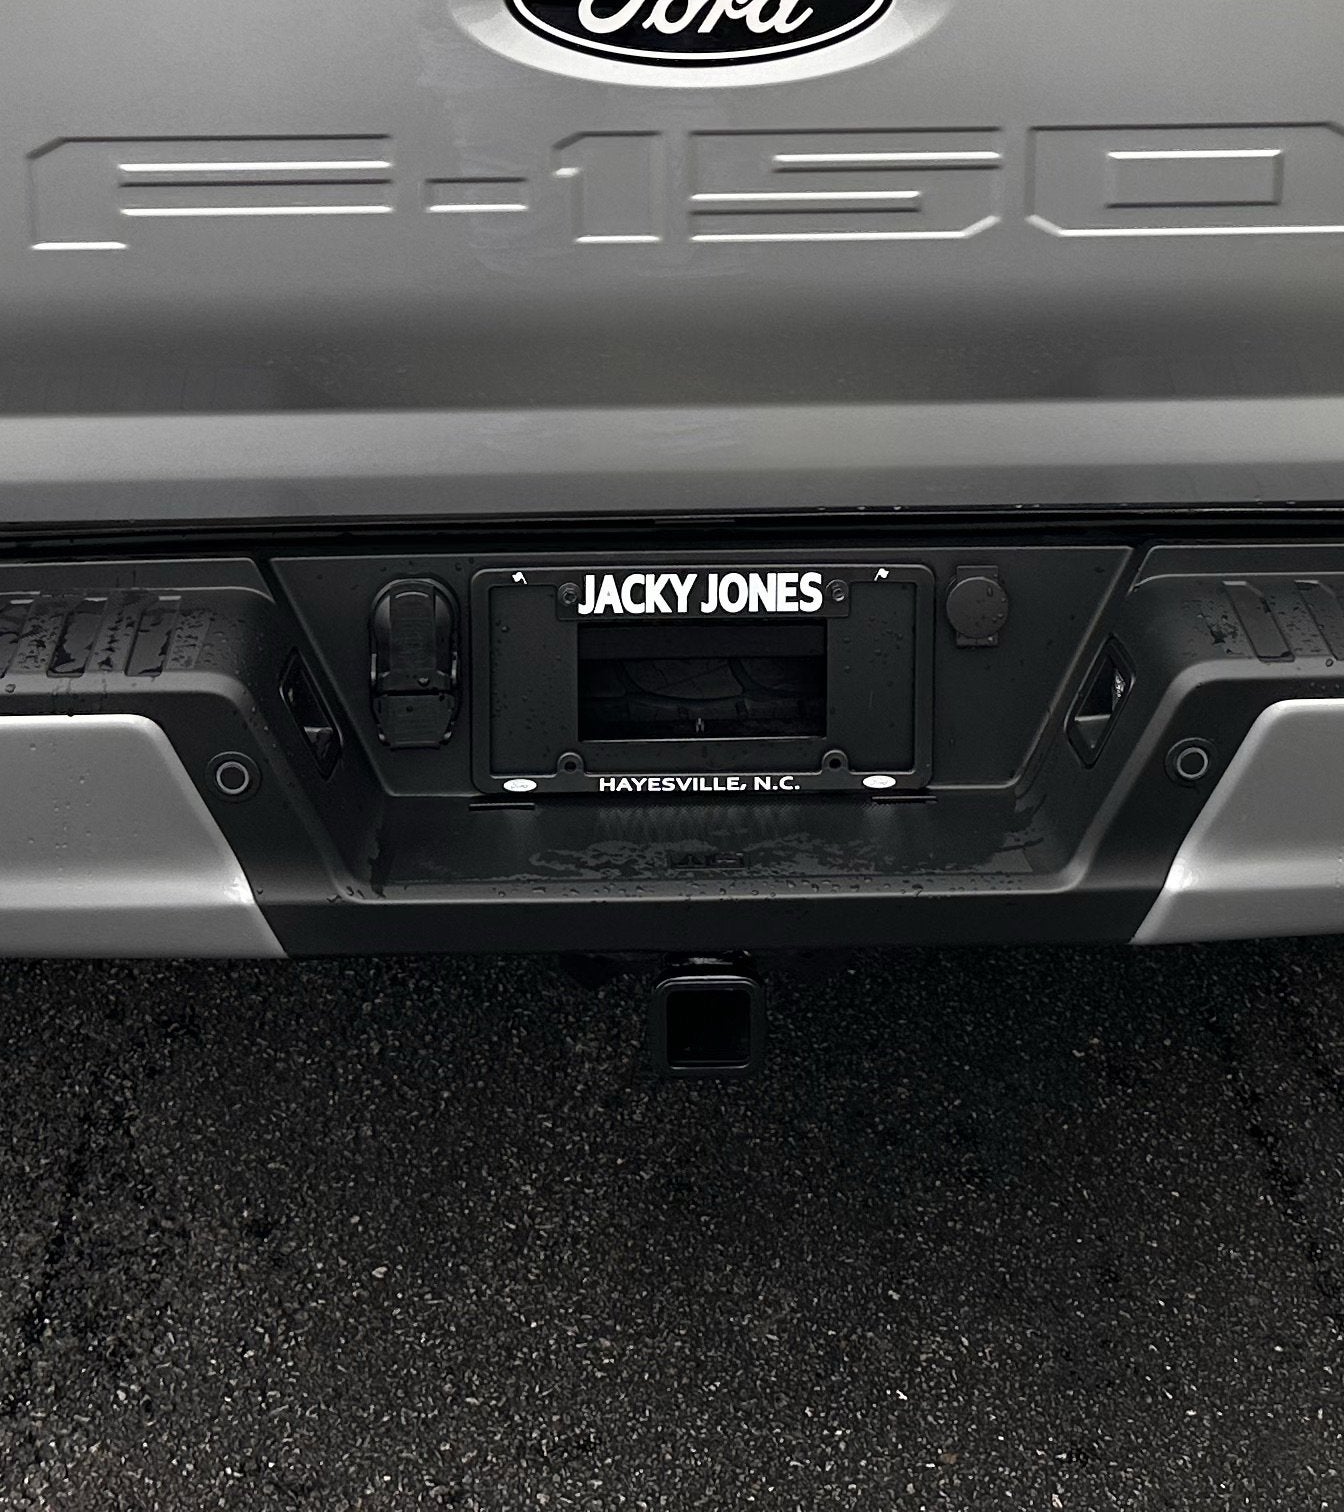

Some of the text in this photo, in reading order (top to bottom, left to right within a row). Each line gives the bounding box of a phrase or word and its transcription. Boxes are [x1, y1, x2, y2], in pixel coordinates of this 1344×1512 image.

[577, 571, 823, 615] JACKY JONES
[598, 775, 801, 792] HAYESVILLE, N.C.
